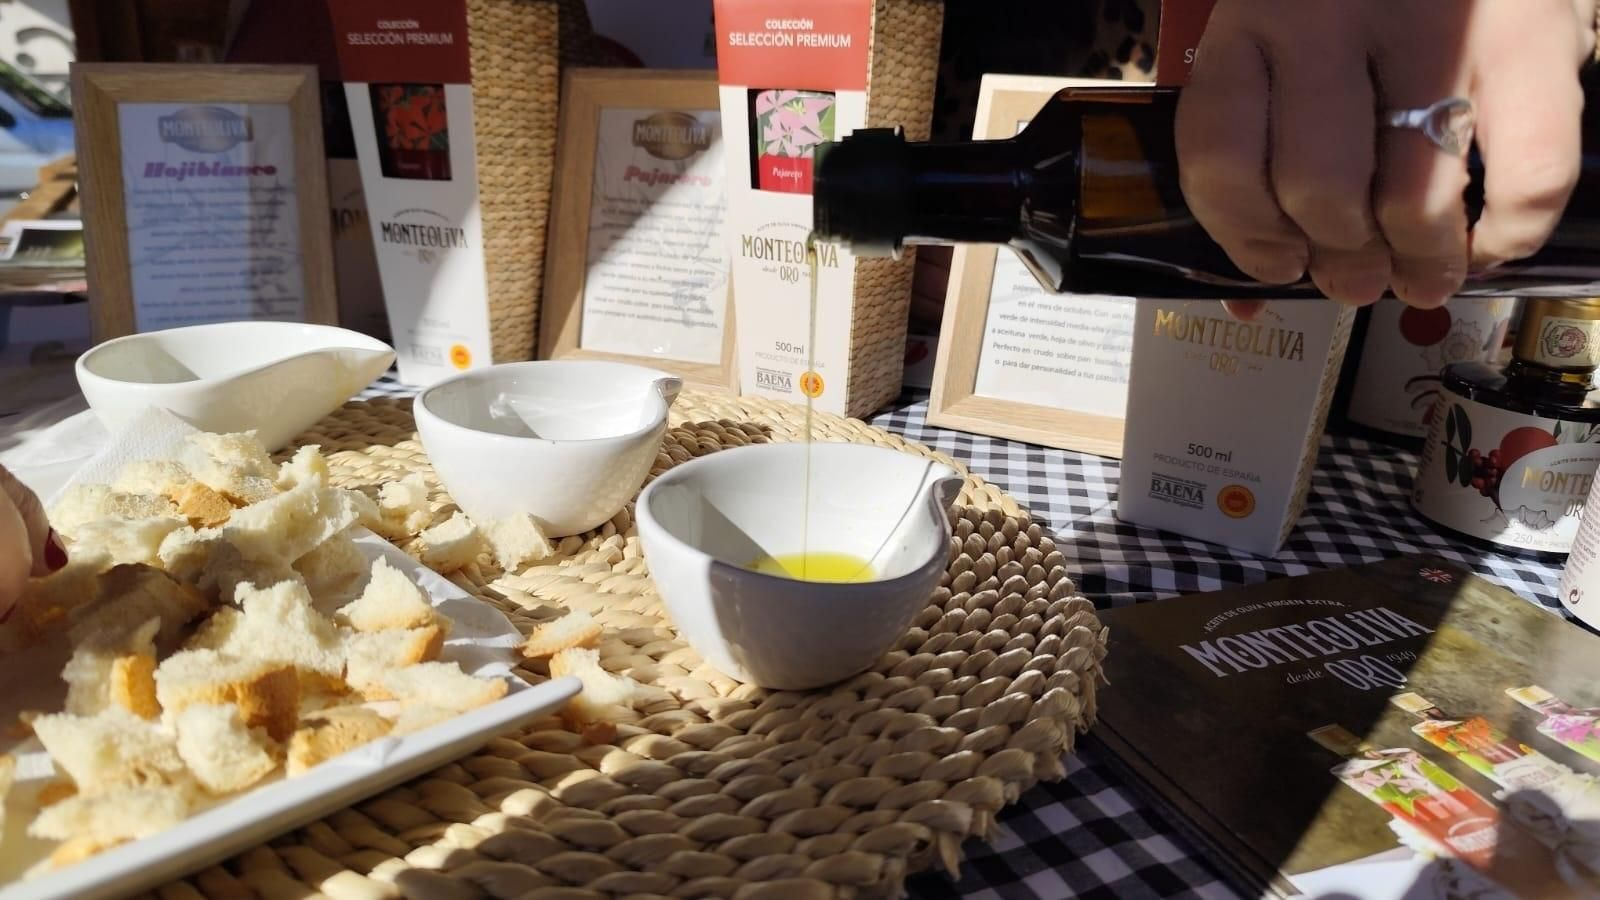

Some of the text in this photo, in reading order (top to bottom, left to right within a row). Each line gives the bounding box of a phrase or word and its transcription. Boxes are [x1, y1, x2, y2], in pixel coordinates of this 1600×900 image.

[765, 18, 814, 30] COLECCIÓN
[347, 31, 454, 45] SELECCIÓN PREMIUM
[729, 31, 852, 48] SELECCIÓN PREMIUM
[144, 162, 277, 182] Hojiblanco
[623, 165, 712, 187] Pajarero
[780, 265, 799, 284] ORO
[1029, 316, 1066, 329] intensidad
[997, 328, 1026, 338] aceituna
[775, 341, 804, 355] 500 ml
[992, 342, 1021, 353] Perfecto
[1033, 348, 1054, 358] crudo
[1002, 359, 1018, 368] para
[1018, 361, 1031, 369] dar
[1031, 363, 1077, 377] personalidad
[756, 372, 793, 388] BAENA
[1187, 442, 1233, 463] 500 ml
[1152, 452, 1205, 473] PRODUCTO
[1206, 464, 1222, 476] DE
[1223, 467, 1262, 483] ESPAÑA
[1150, 478, 1204, 502] BAENA
[1521, 467, 1592, 496] MONTE
[1564, 498, 1585, 520] OR
[1513, 531, 1534, 544] 250
[1203, 599, 1346, 632] ACEITE DE OLIVA VIRGEN EXTRA
[1286, 651, 1417, 691] desde ORO 1949
